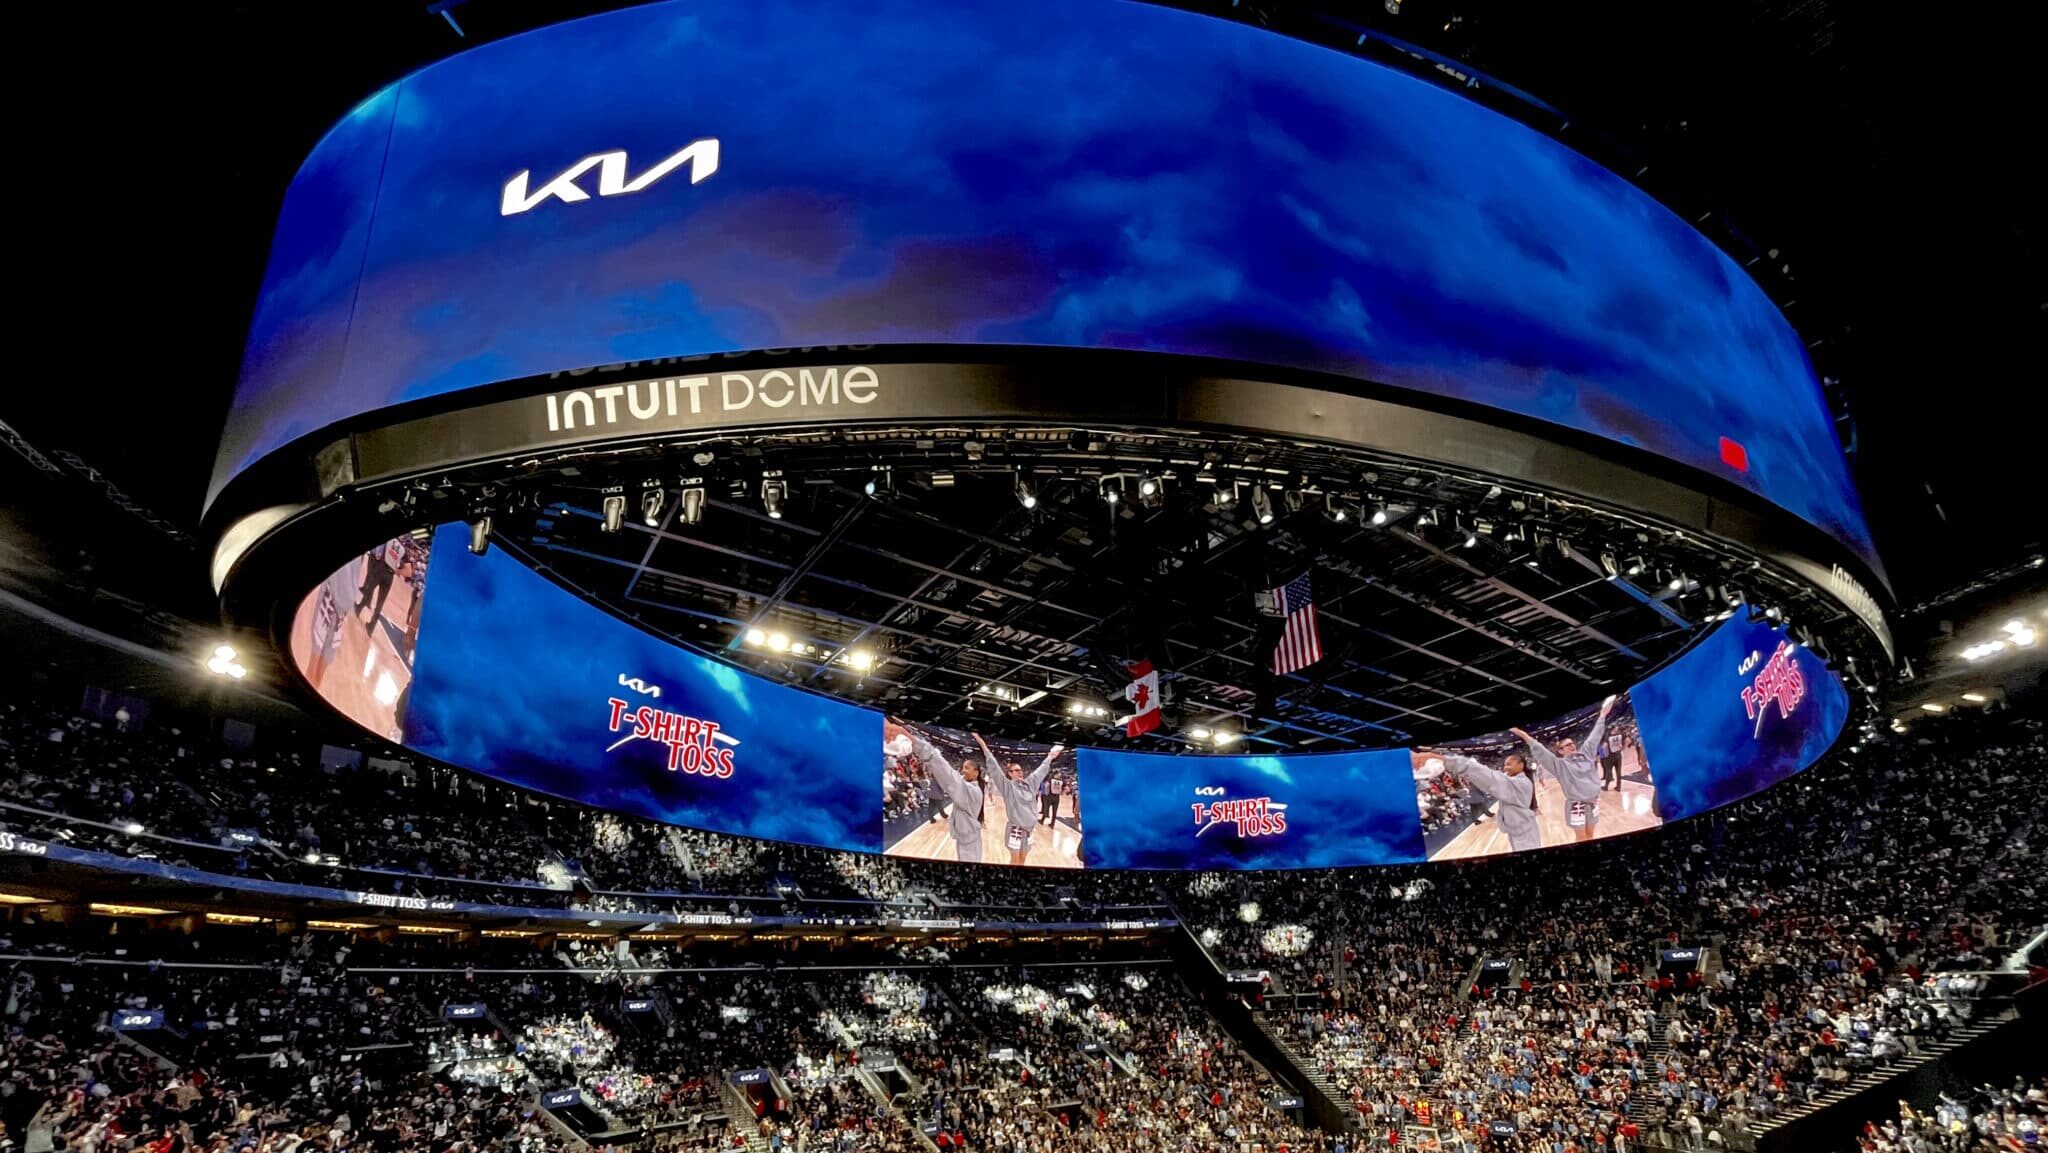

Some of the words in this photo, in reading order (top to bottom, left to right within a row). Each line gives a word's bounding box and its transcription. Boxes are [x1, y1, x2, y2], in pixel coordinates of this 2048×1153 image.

[608, 697, 720, 752] T-SHIRT
[666, 740, 734, 778] TOSS
[1191, 797, 1271, 824] T-SHIRT
[1237, 812, 1286, 838] TOSS
[358, 892, 398, 907] T-SHIRT
[399, 897, 427, 909] TOSS
